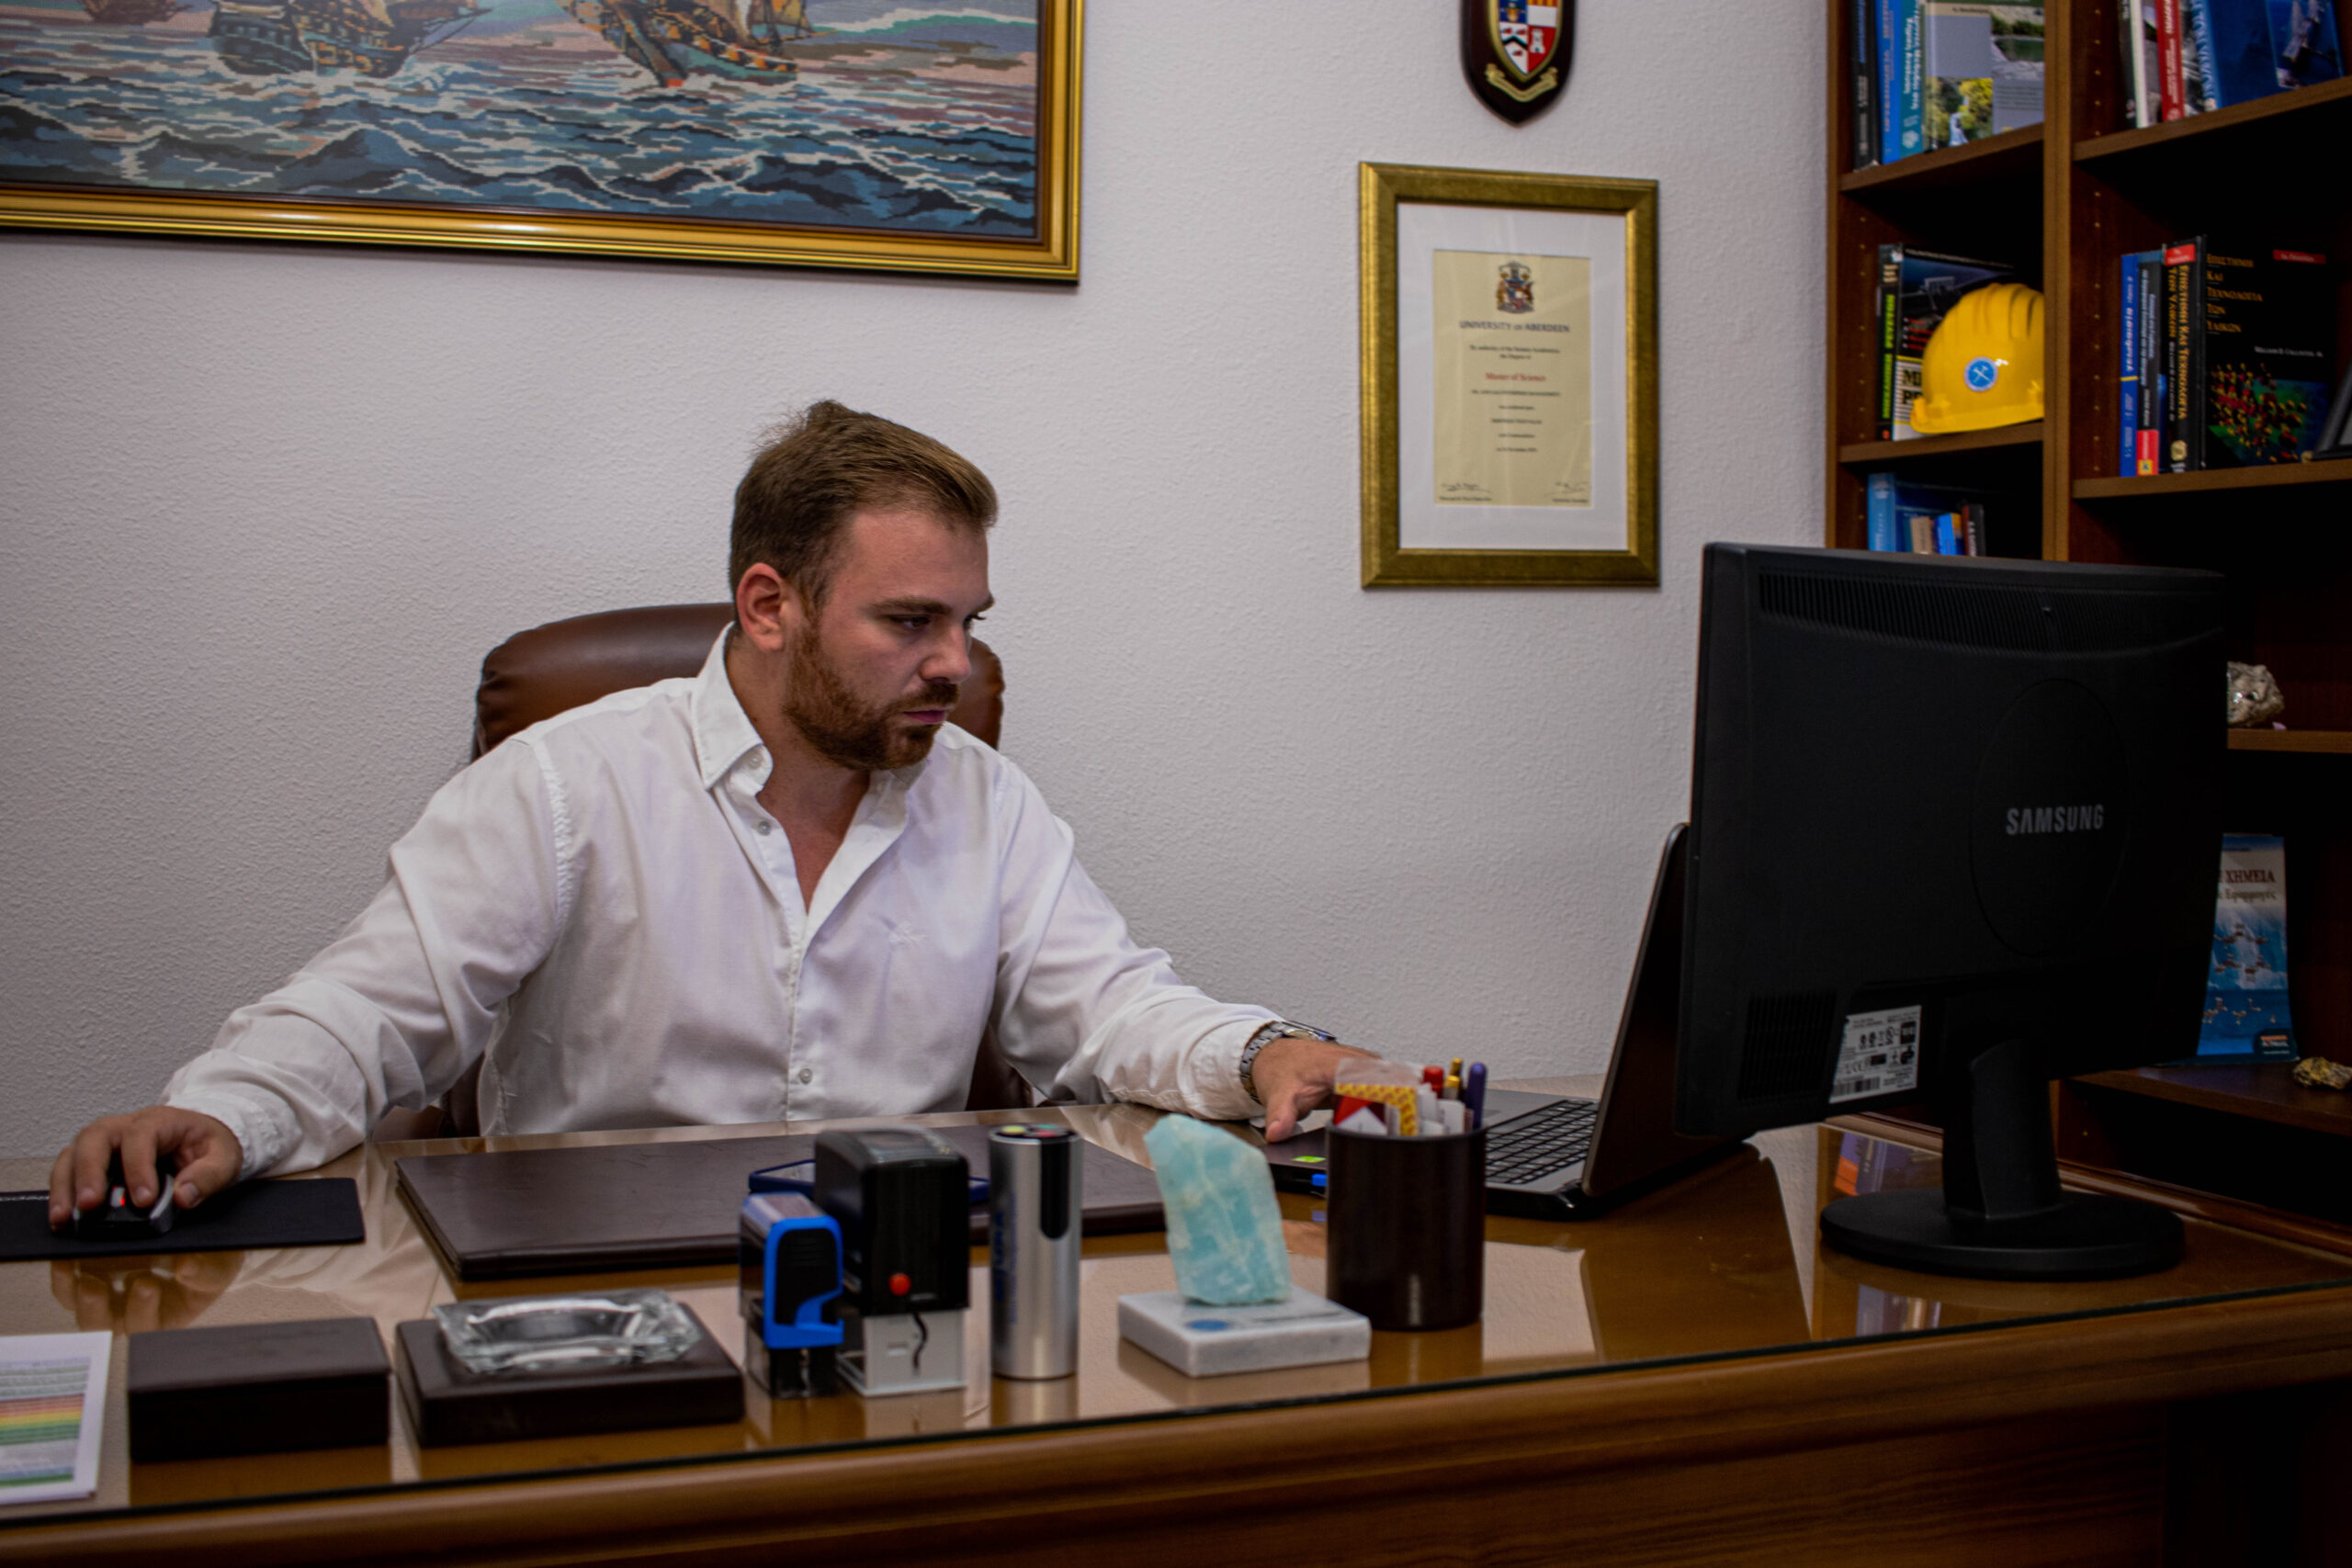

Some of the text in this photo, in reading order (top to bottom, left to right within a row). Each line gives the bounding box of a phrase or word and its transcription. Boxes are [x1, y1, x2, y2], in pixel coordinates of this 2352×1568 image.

[1459, 321, 1511, 330] UNIVERSITY
[1525, 323, 1570, 333] ABERDEEN
[2006, 804, 2104, 835] SAMSUNG
[2225, 870, 2276, 883] ΧΗΜΕΙΑ
